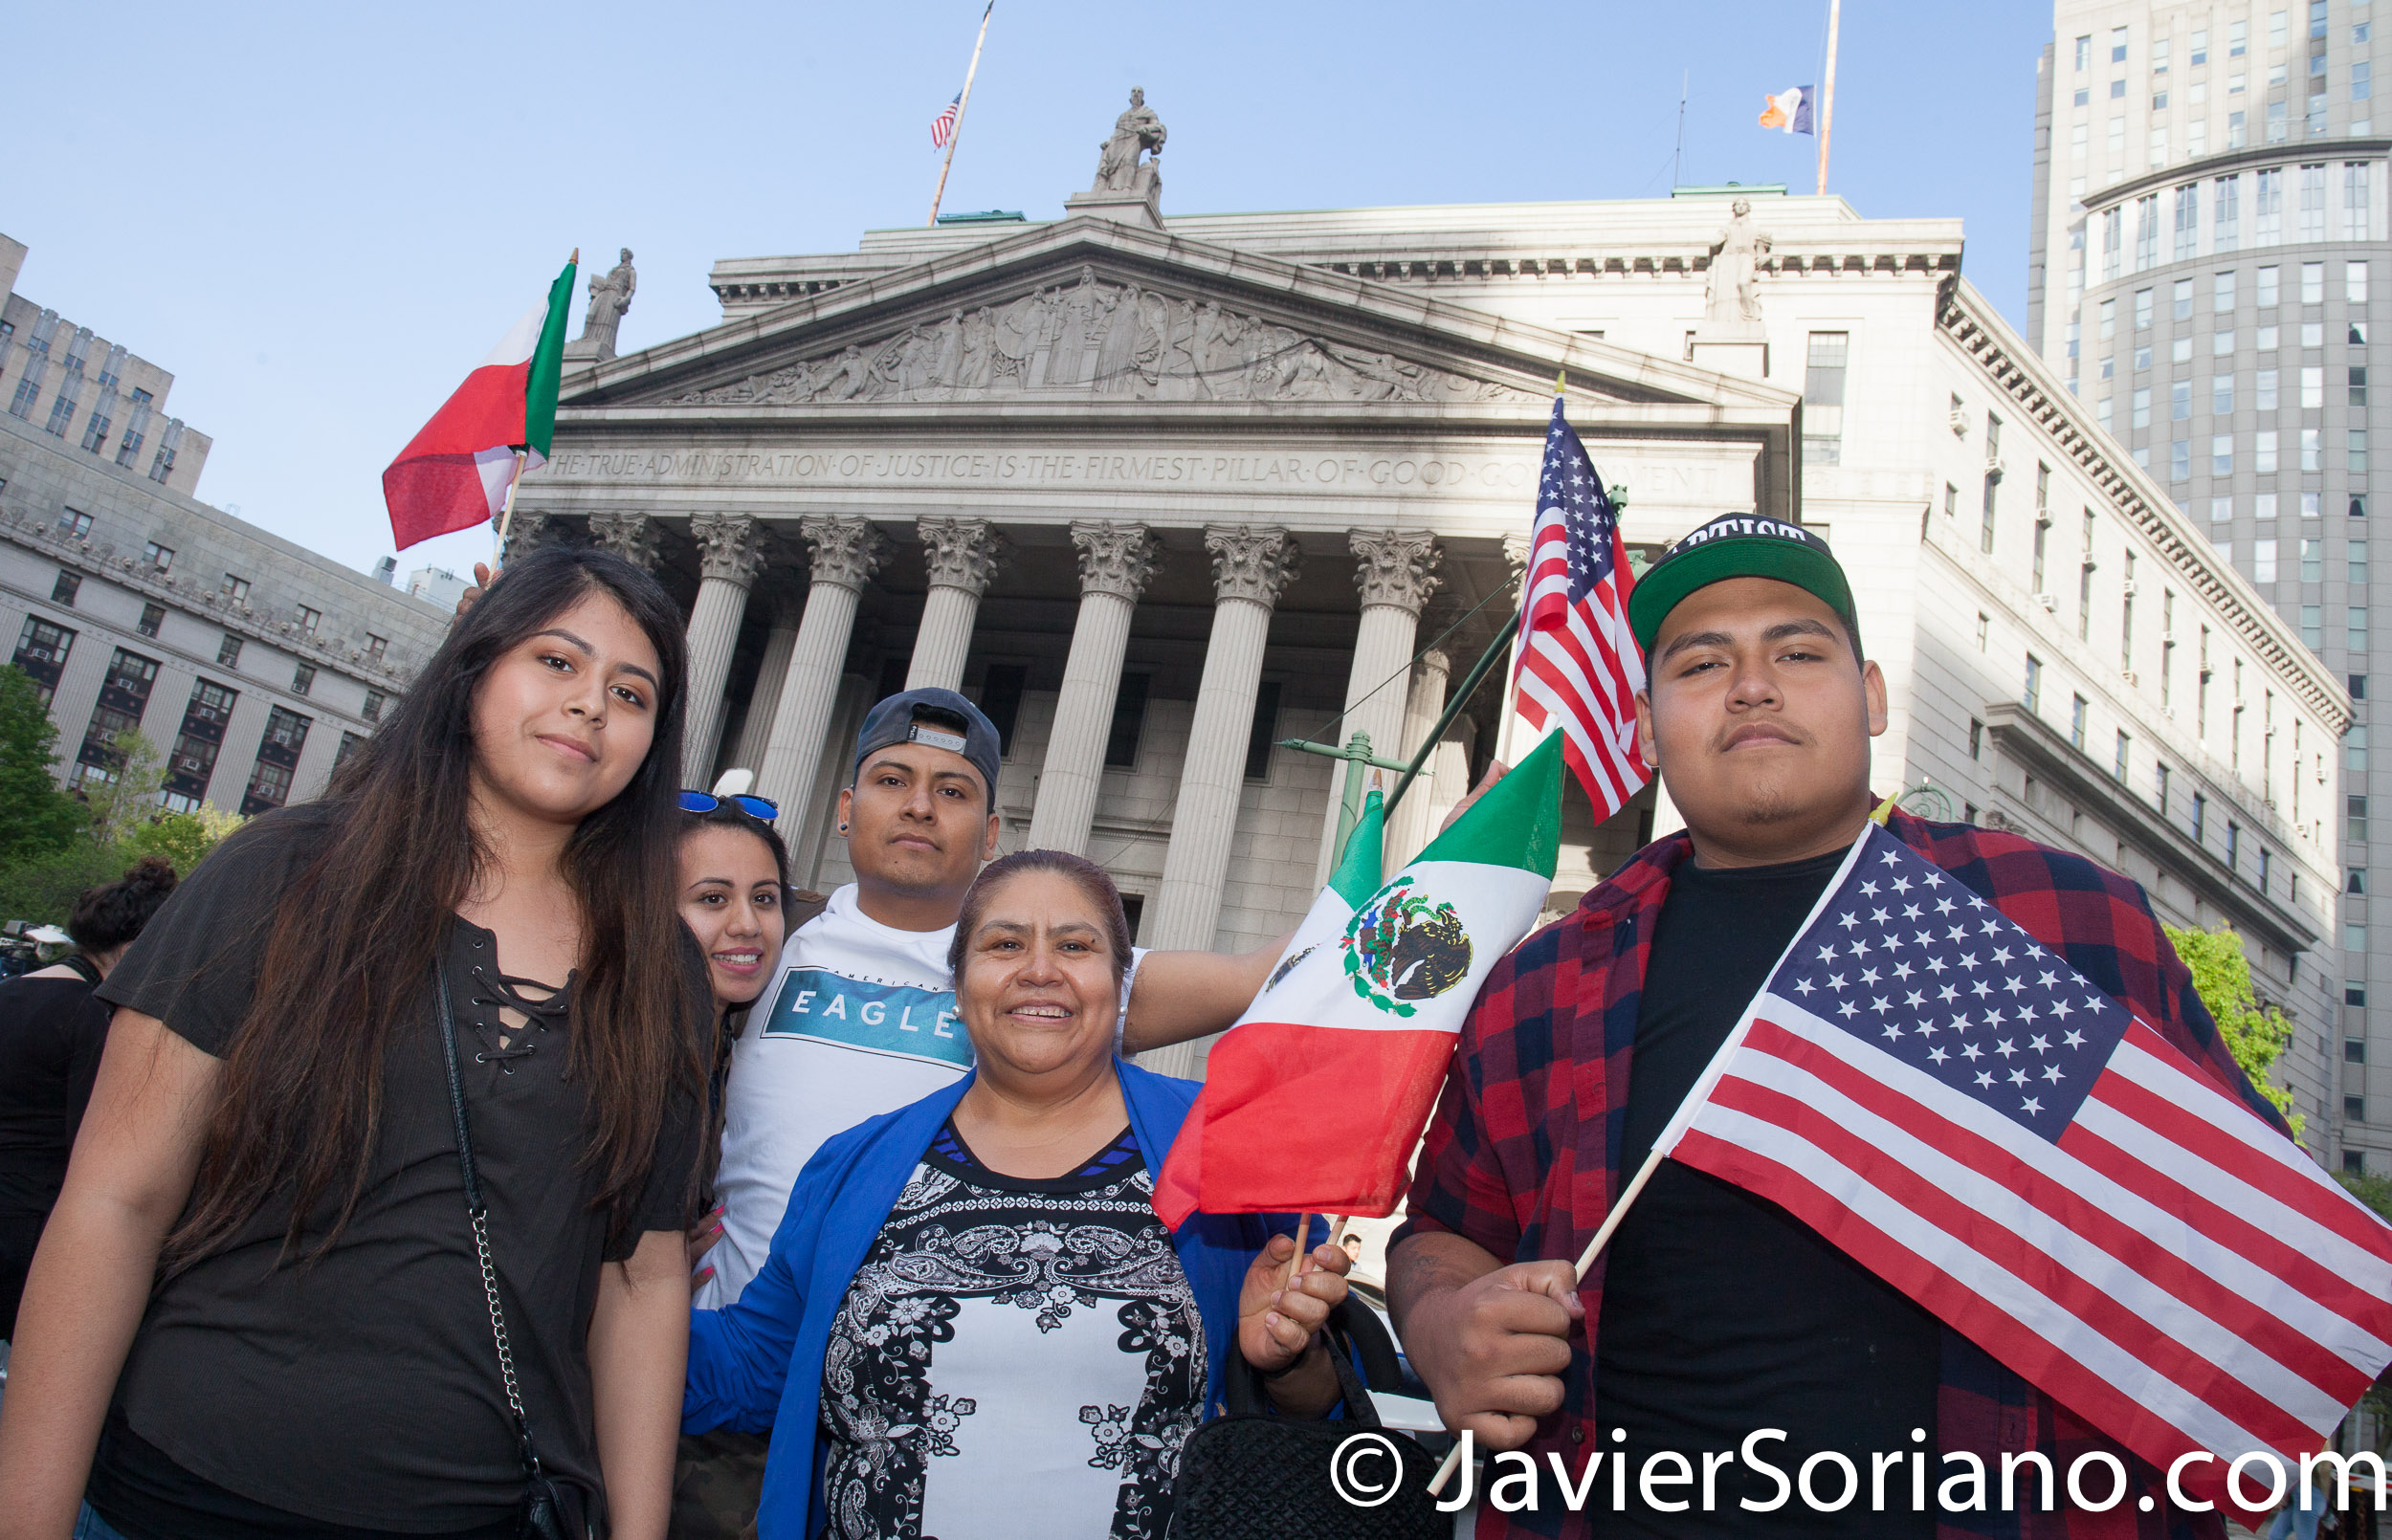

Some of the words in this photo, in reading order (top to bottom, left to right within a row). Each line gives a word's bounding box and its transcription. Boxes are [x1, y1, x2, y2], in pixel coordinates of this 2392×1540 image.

[587, 454, 640, 475] TRUE
[642, 454, 833, 476] ADMINISTRATION
[839, 454, 875, 477] OF
[876, 454, 985, 478] JUSTICE
[993, 454, 1018, 478] IS
[1027, 454, 1075, 478] THE
[1084, 455, 1203, 481] FIRMEST
[1209, 456, 1305, 483] PILLAR
[1315, 458, 1359, 484] OF
[1368, 459, 1467, 486] GOOD
[1479, 461, 1718, 495] GONMENT
[833, 970, 940, 992] AMERICAN
[791, 990, 957, 1039] EAGLE
